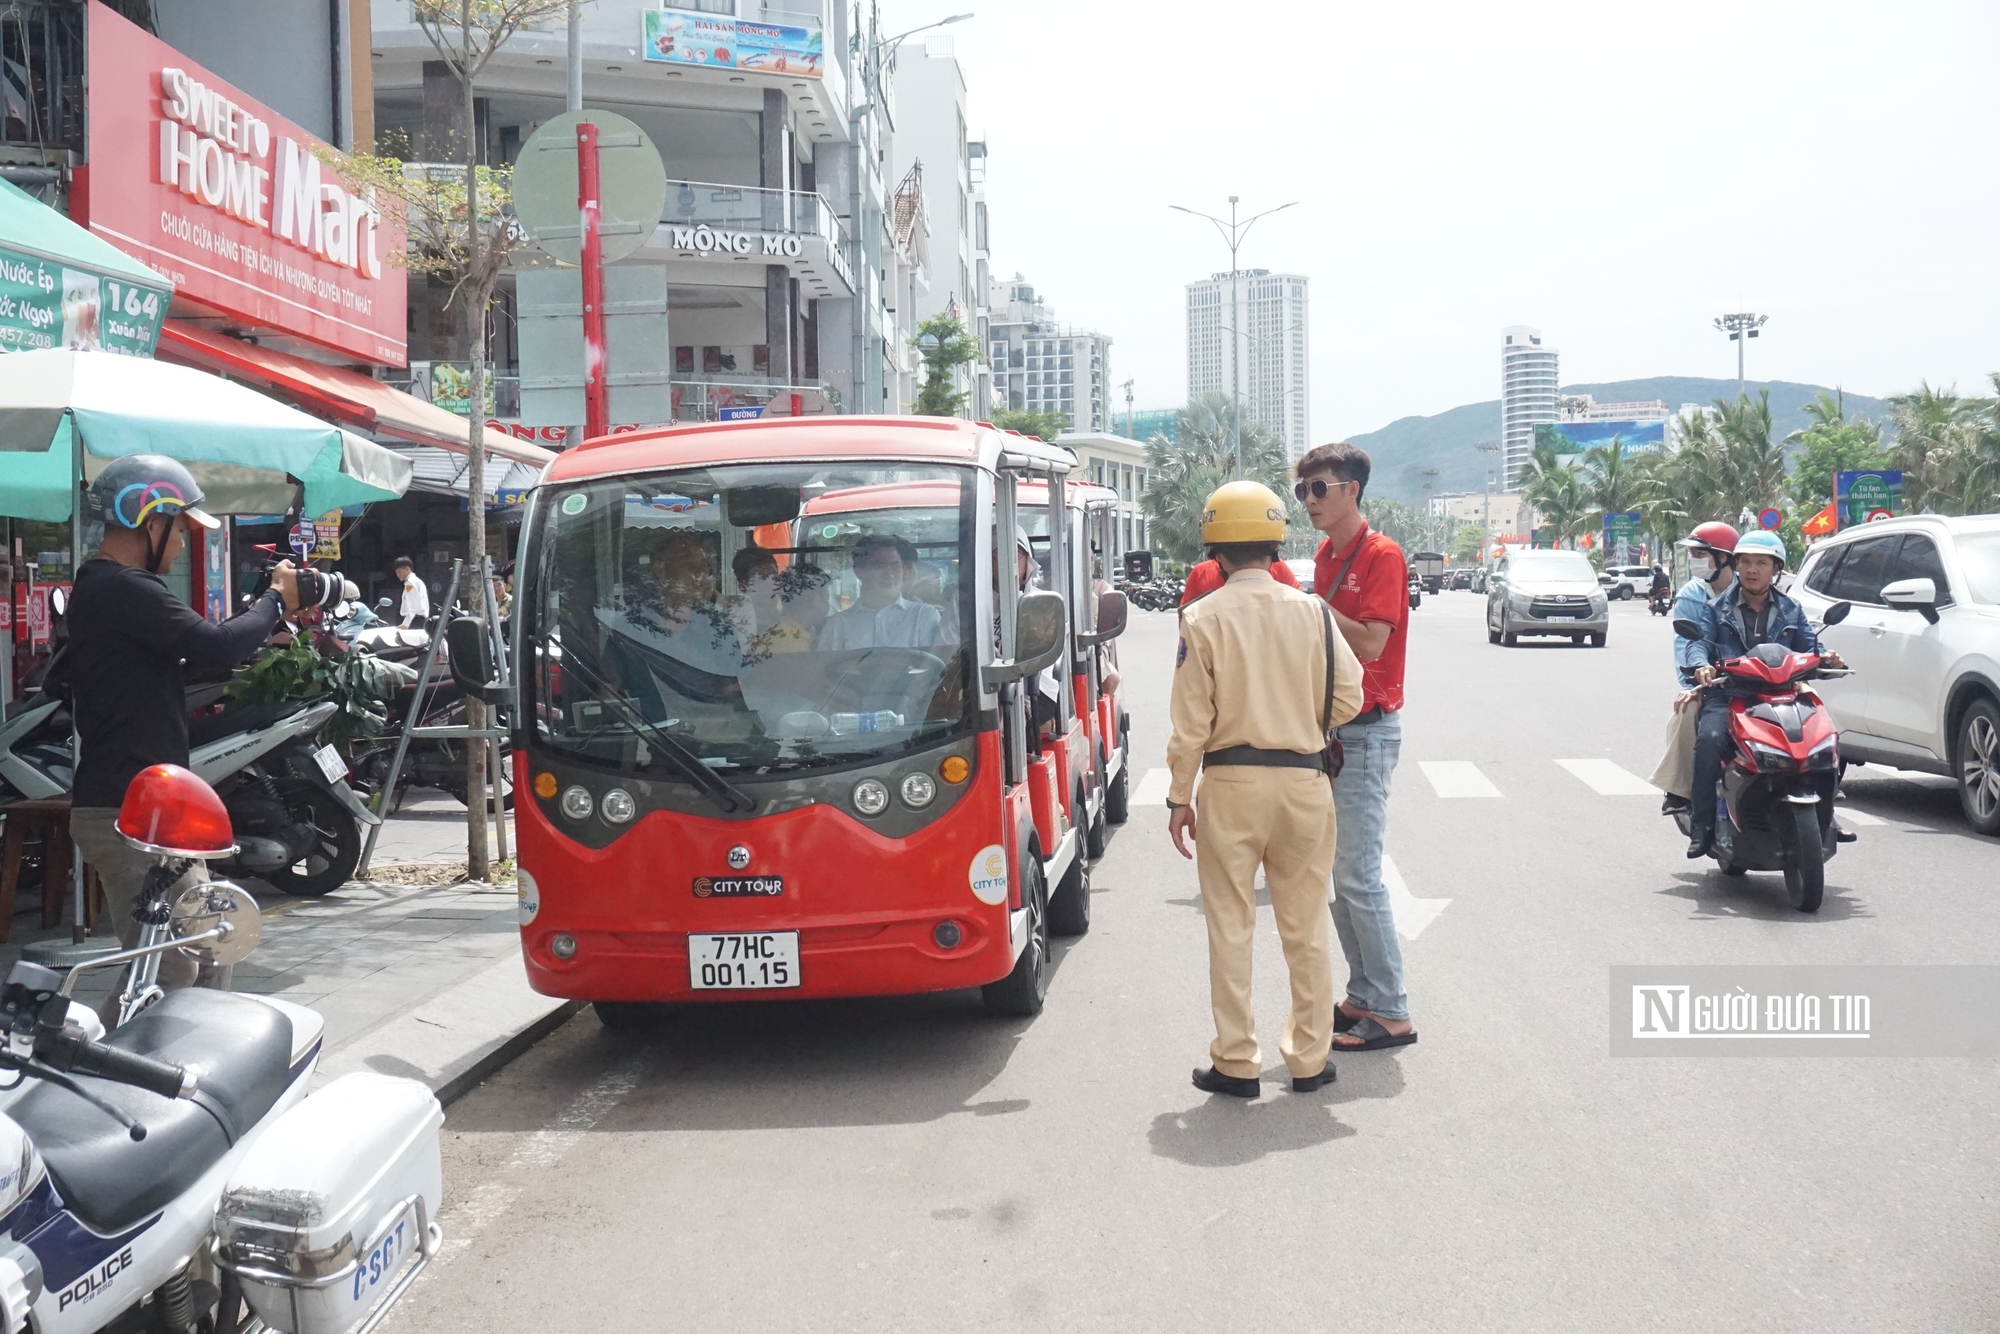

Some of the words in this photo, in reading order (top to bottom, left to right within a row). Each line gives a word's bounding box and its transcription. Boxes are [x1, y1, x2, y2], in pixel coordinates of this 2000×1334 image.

[737, 24, 764, 37] MỘNG
[162, 67, 253, 153] SWEET
[160, 120, 269, 228] HOME
[272, 136, 381, 280] Mart
[160, 210, 191, 243] CHUỖI
[192, 224, 212, 249] CỬA
[214, 231, 239, 262] HÀNG
[240, 243, 259, 272] TIỆN
[259, 248, 273, 275] ÍCH
[273, 255, 285, 279] VÀ
[285, 264, 317, 294] NHƯỢNG
[672, 223, 752, 258] MỘNG
[761, 233, 804, 257] MƠ
[0, 258, 34, 286] Nước
[38, 262, 54, 294] Ép
[19, 300, 54, 330] Ngọt
[108, 282, 159, 321] 164
[108, 319, 135, 338] Xuân
[731, 409, 757, 419] ĐƯỜNG
[713, 881, 742, 893] CITY
[745, 880, 782, 896] TOUR
[973, 879, 993, 890] CITY
[711, 935, 775, 960] 77HC
[701, 961, 789, 986] 001.15
[353, 1220, 405, 1302] CSGT
[58, 1246, 134, 1313] POLICE
[83, 1292, 95, 1305] CB
[96, 1279, 114, 1296] 250
